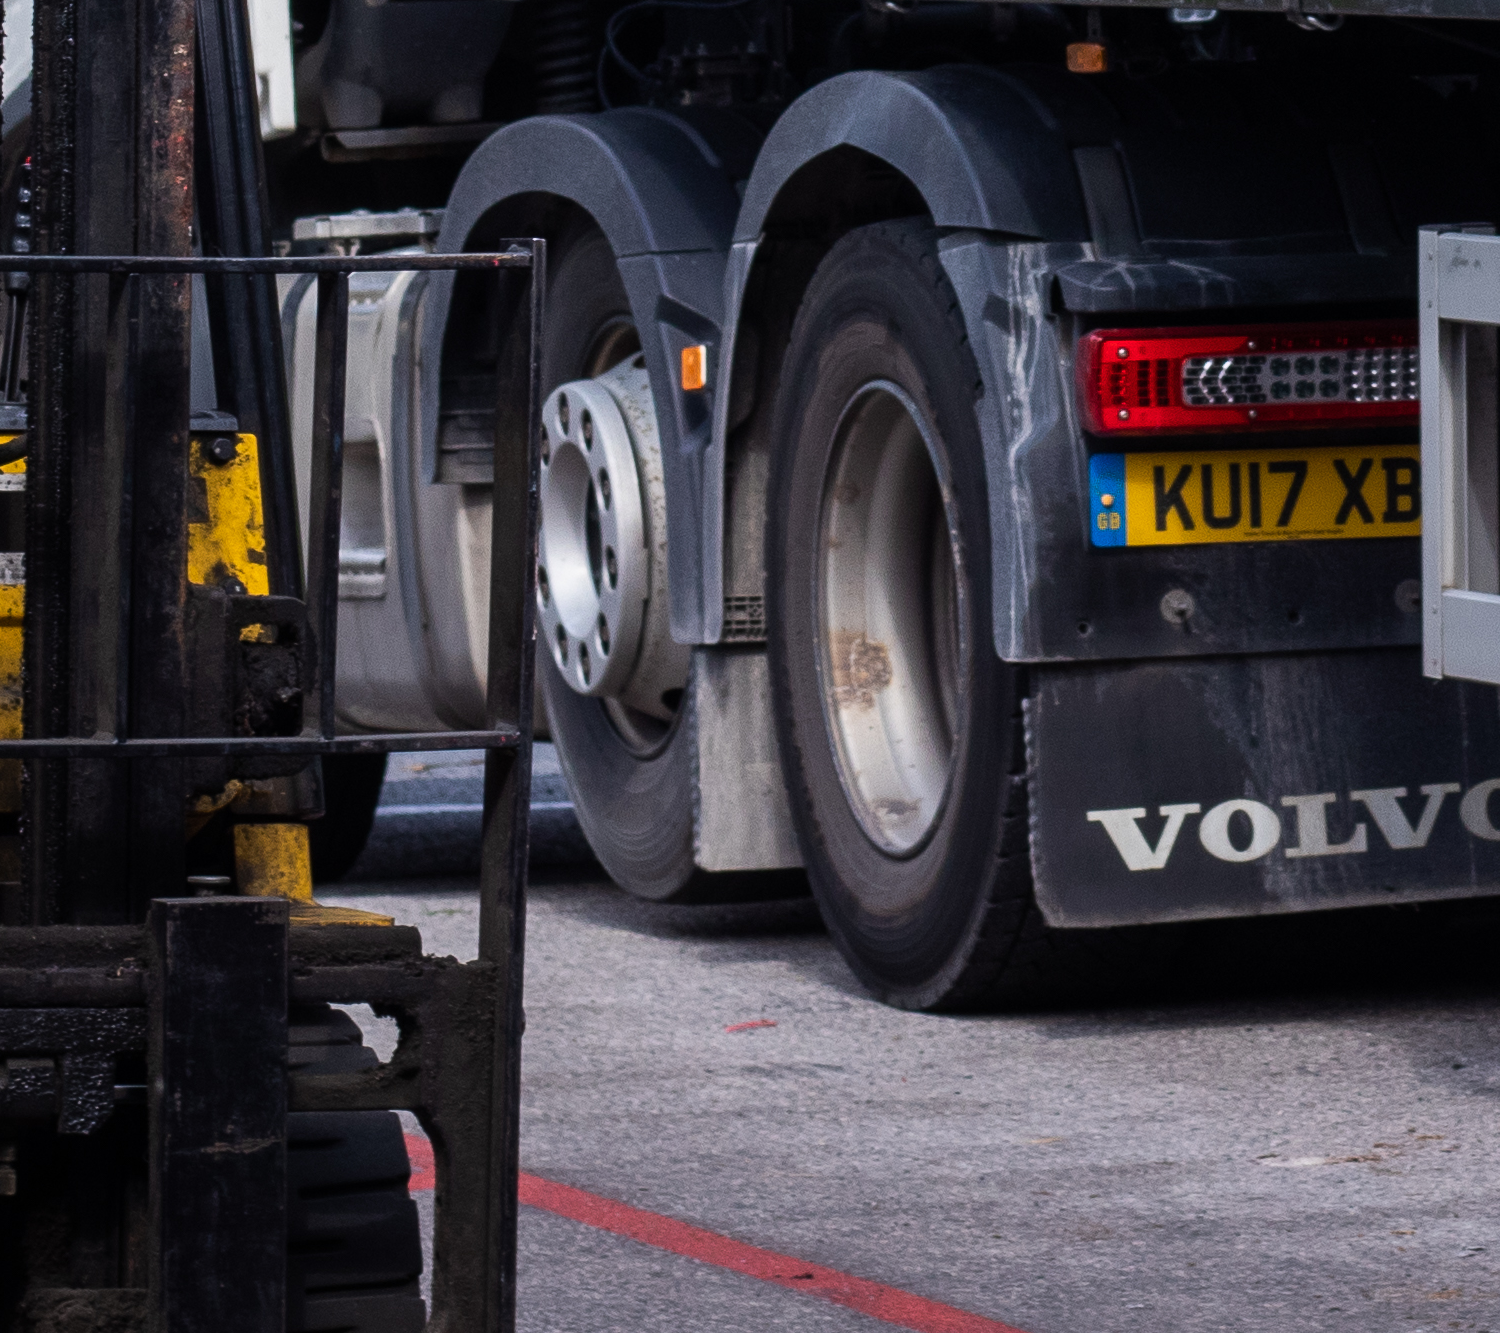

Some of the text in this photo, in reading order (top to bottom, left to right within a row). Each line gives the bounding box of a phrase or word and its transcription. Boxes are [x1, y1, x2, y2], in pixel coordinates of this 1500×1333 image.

[1153, 456, 1422, 532] KU17 XB
[1096, 512, 1121, 530] GB
